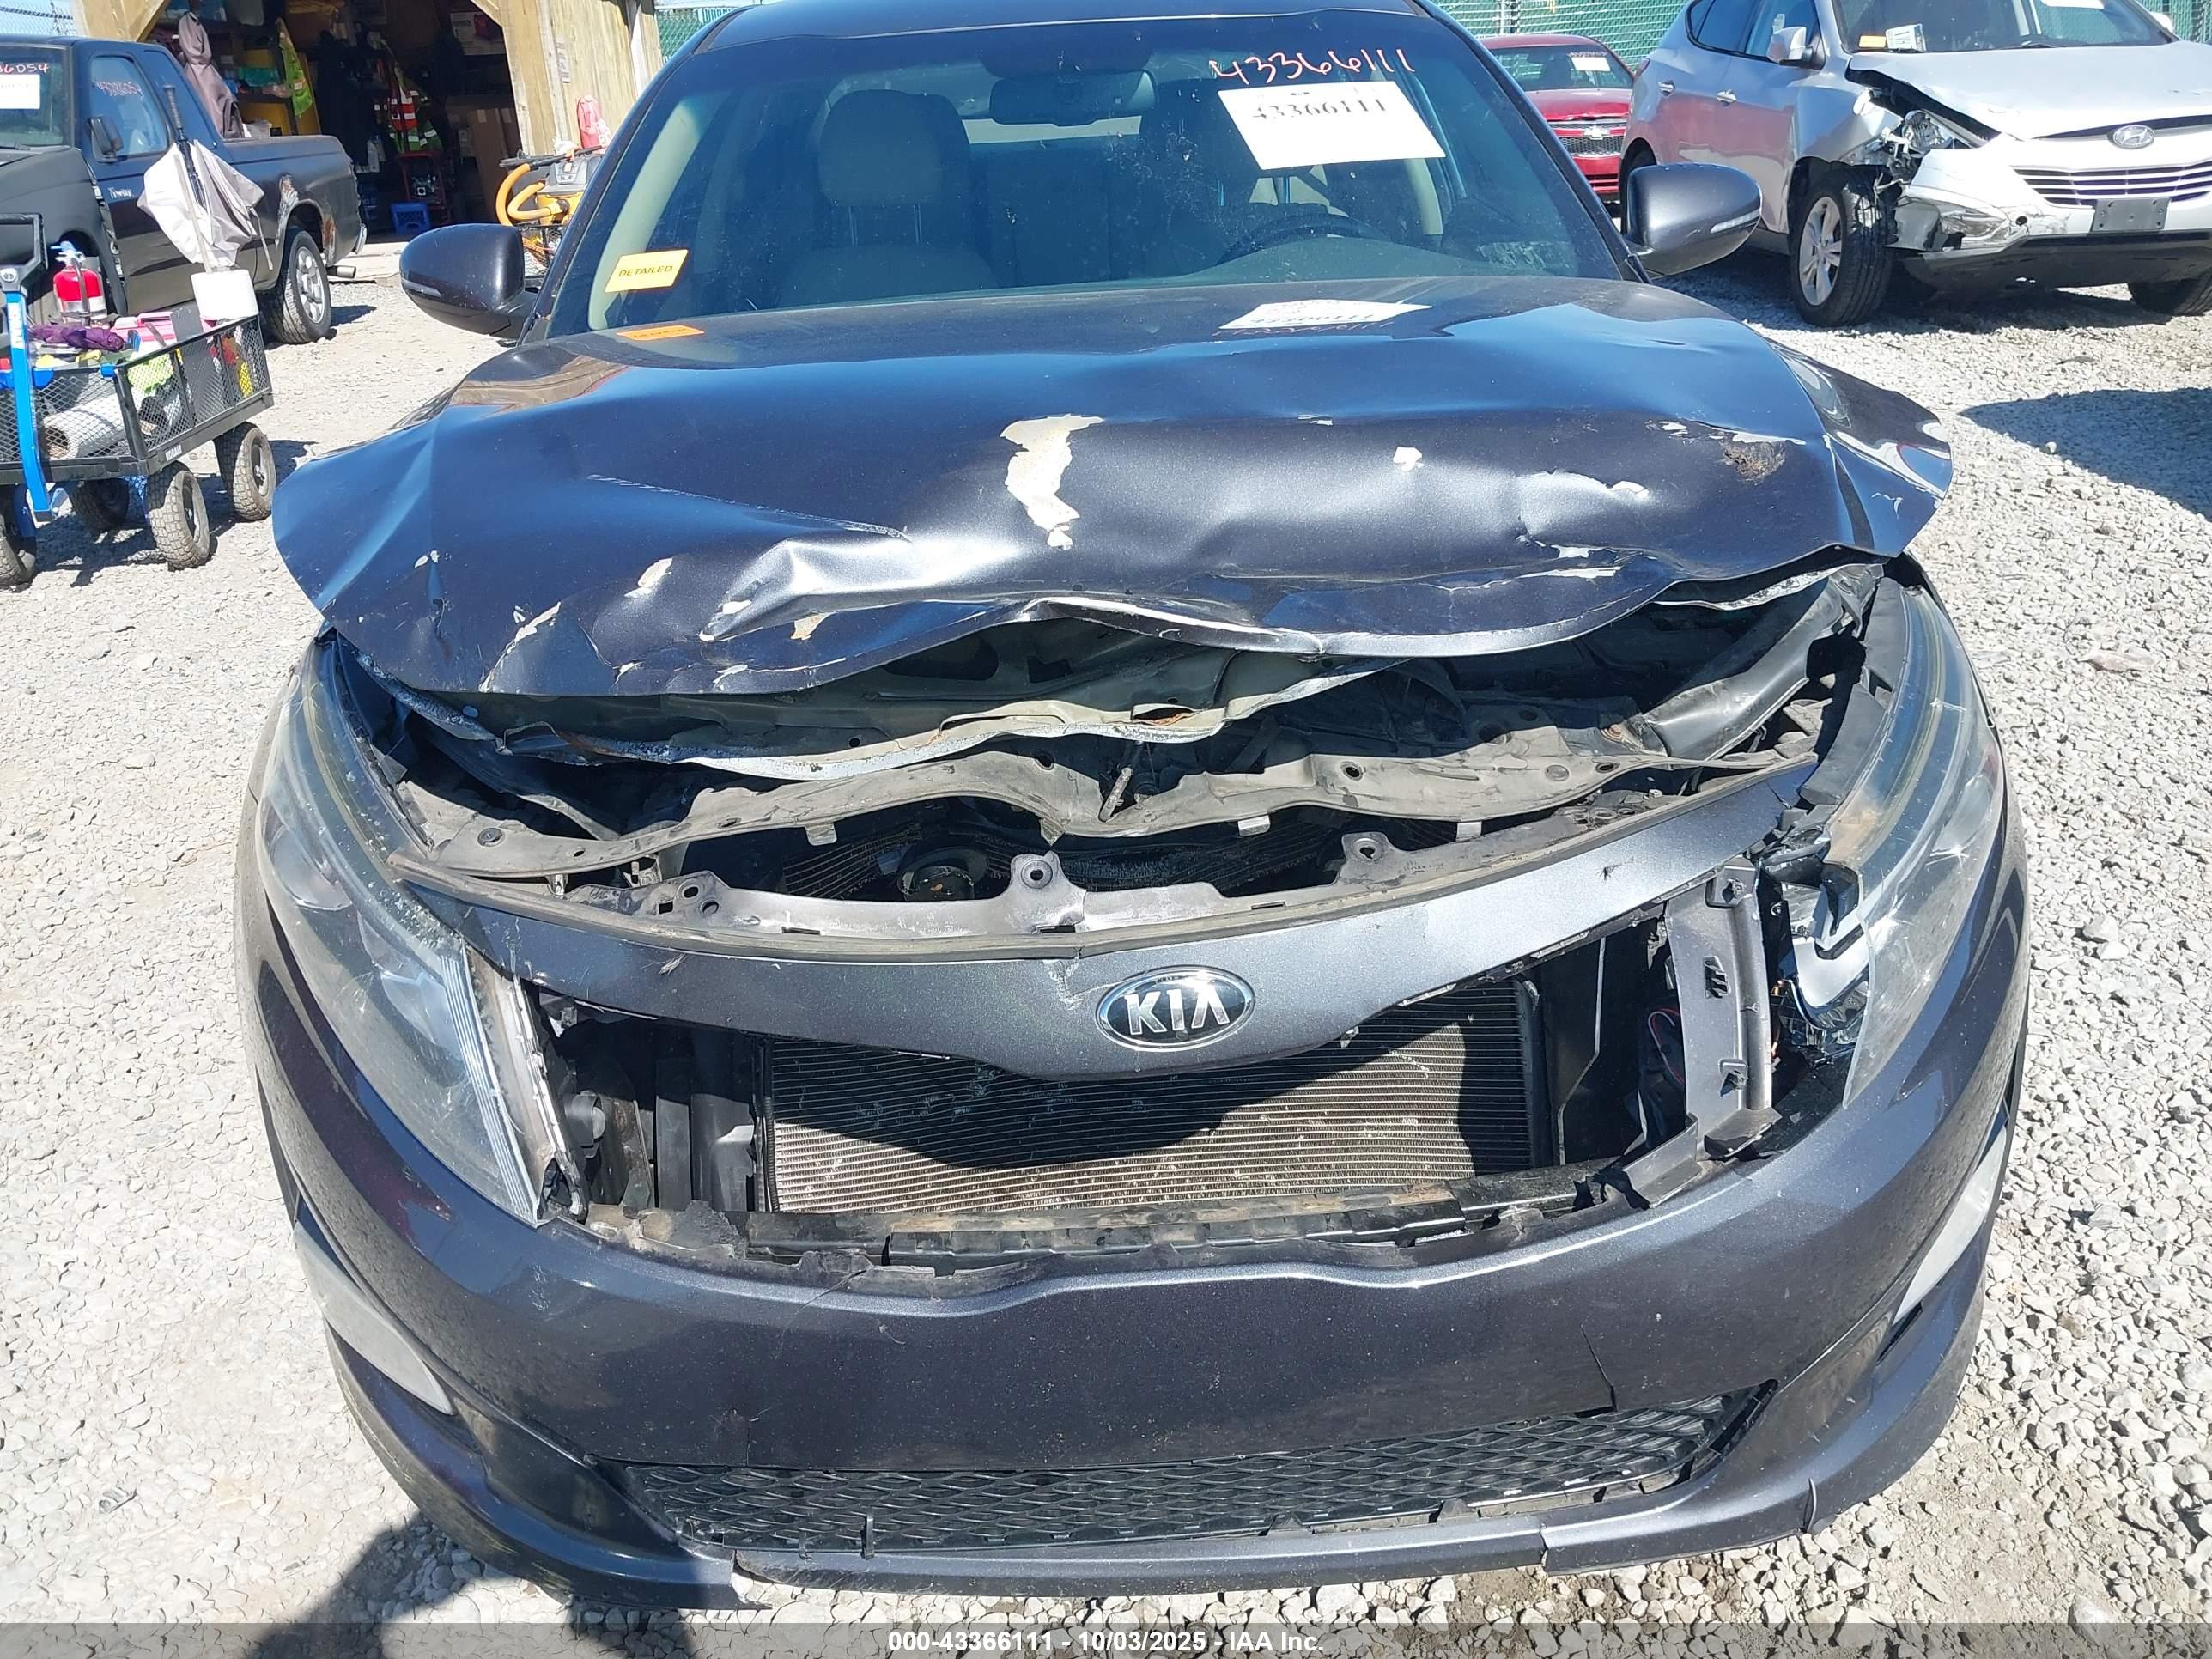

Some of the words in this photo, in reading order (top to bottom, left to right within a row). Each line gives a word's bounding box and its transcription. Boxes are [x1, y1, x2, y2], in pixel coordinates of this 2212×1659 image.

[1209, 48, 1415, 85] 43366111
[618, 265, 673, 277] DETAILED
[1124, 985, 1231, 1036] KIA
